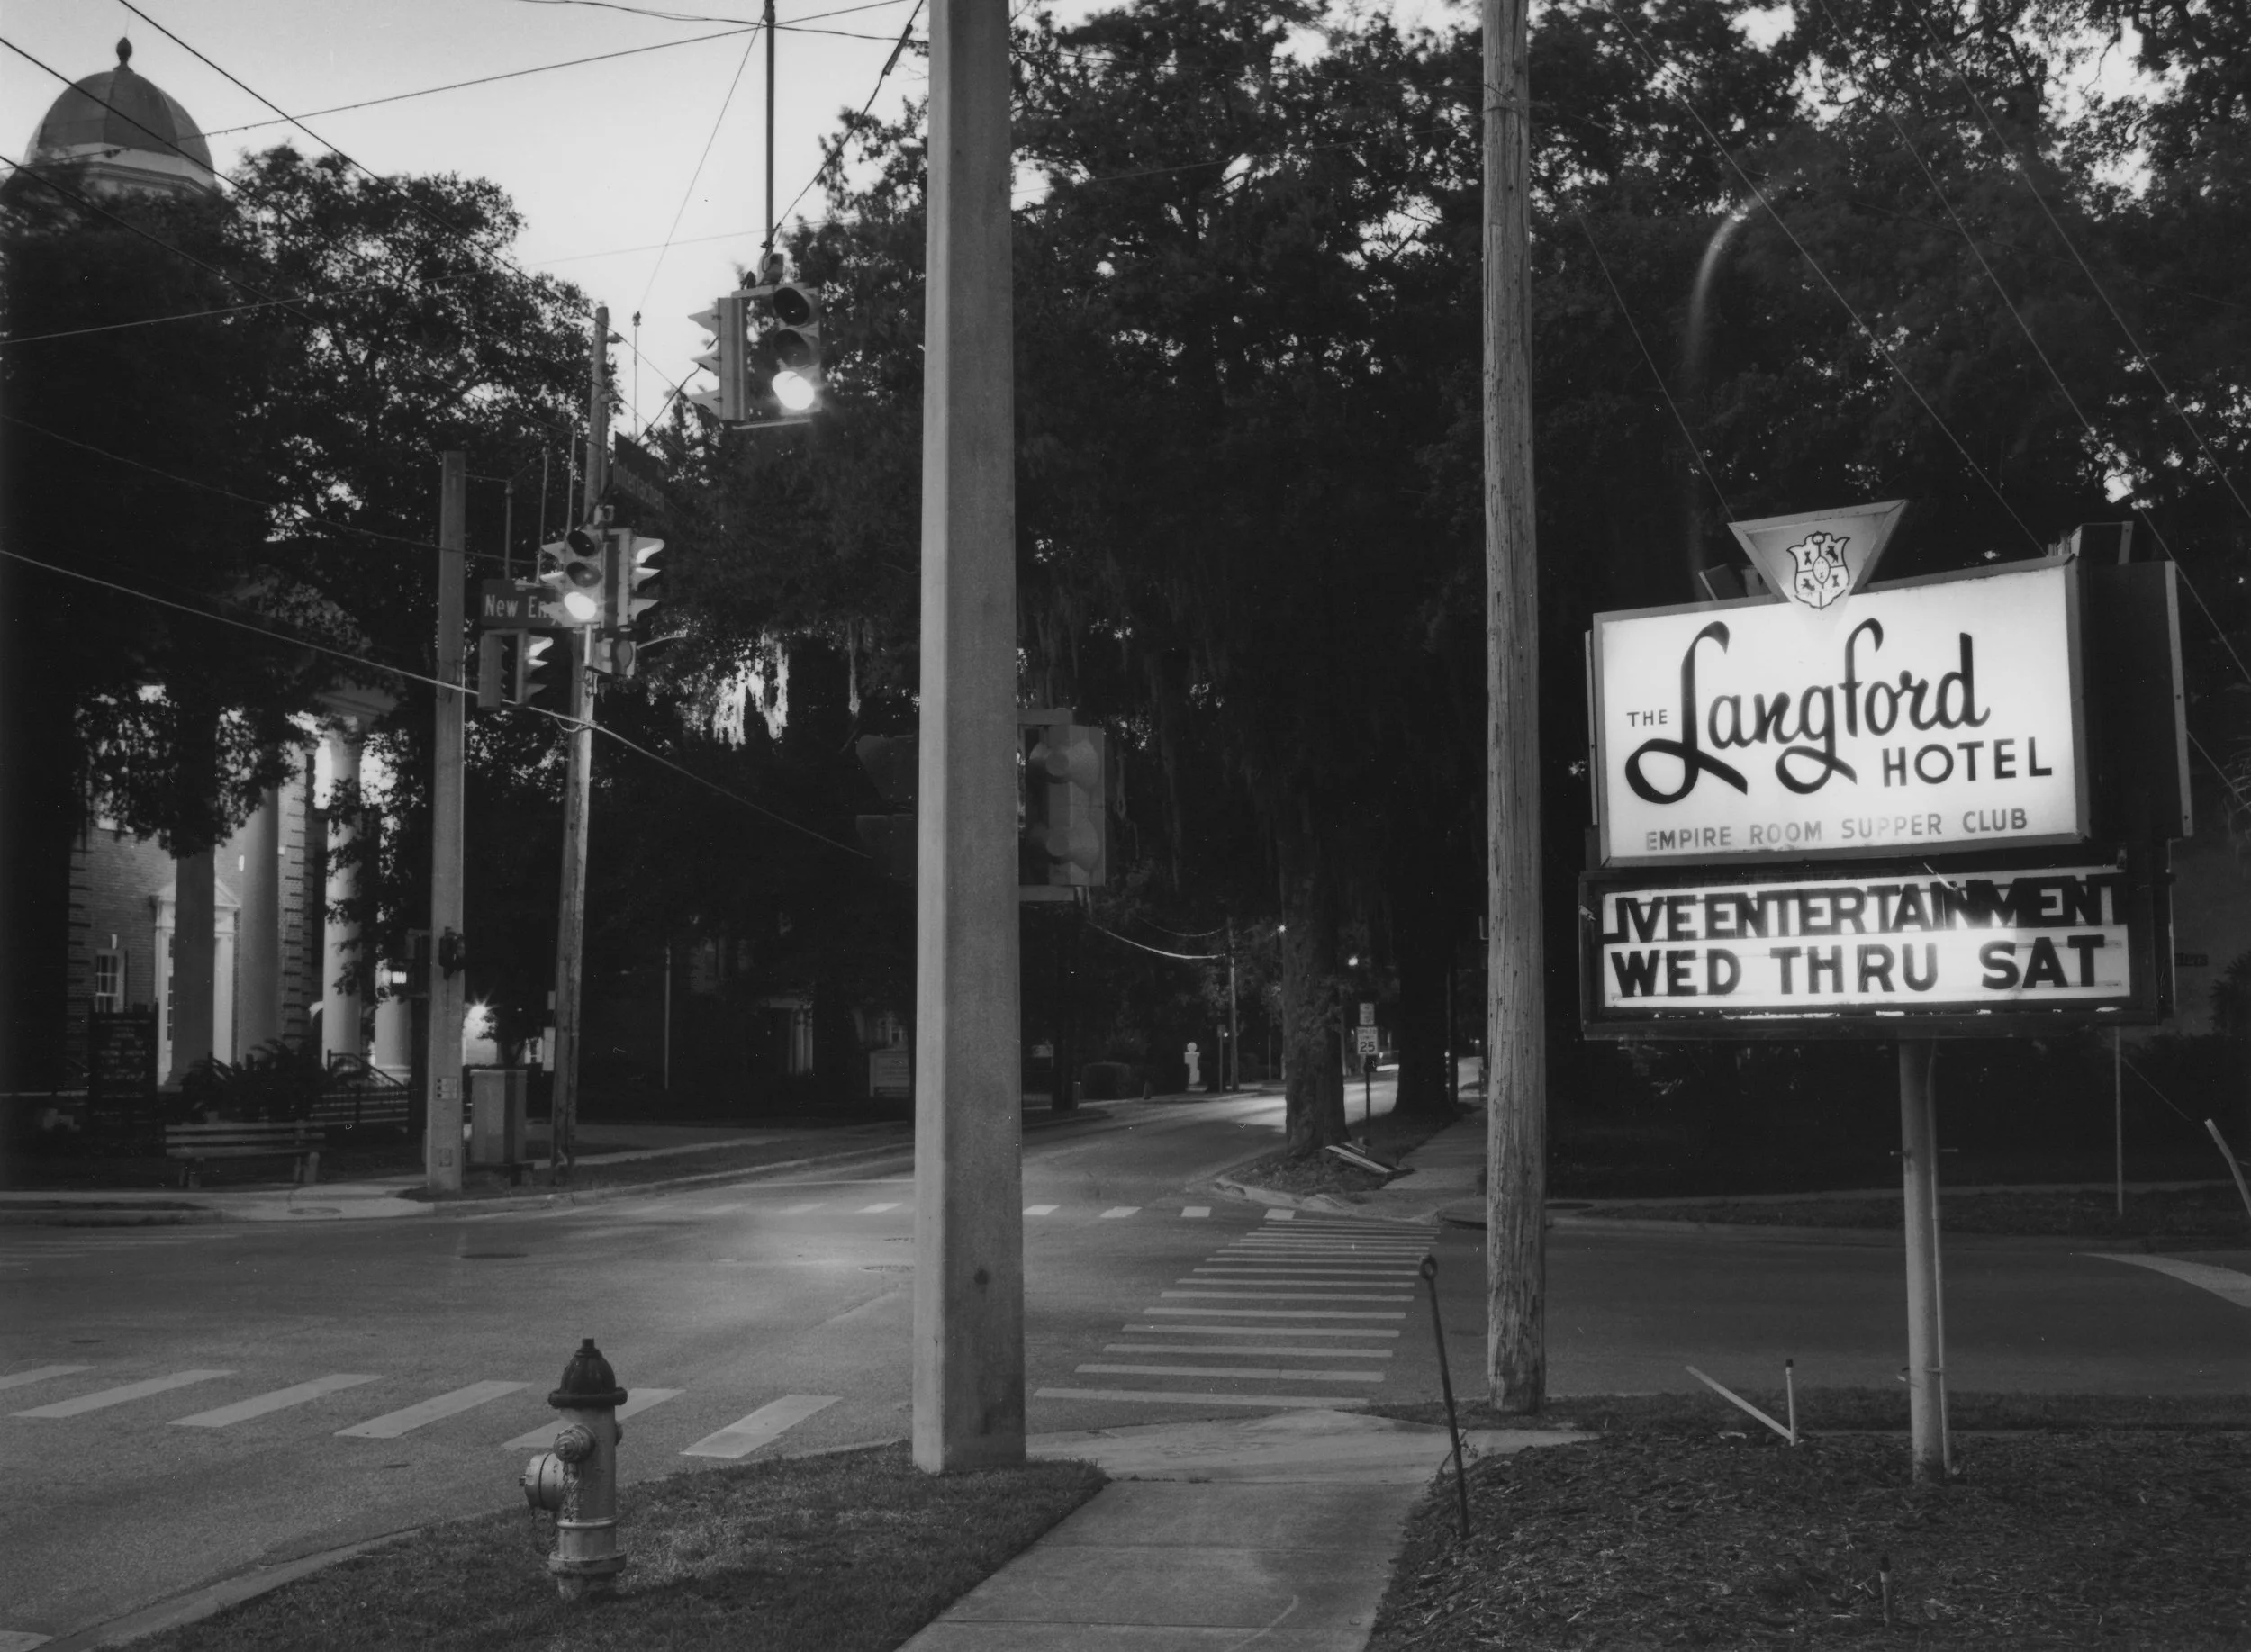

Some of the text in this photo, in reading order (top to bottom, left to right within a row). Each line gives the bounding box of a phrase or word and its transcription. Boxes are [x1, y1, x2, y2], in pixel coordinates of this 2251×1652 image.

[484, 594, 519, 618] New
[1624, 618, 1991, 805] THE Langford
[1882, 736, 2053, 788] HOTEL
[1645, 808, 2028, 853] EMPIRE ROOM SUPPER CLUB
[1704, 874, 2130, 939] ENTERTAINMENT
[1611, 934, 2105, 998] WED THRU SAT
[1360, 1042, 1376, 1052] 25
